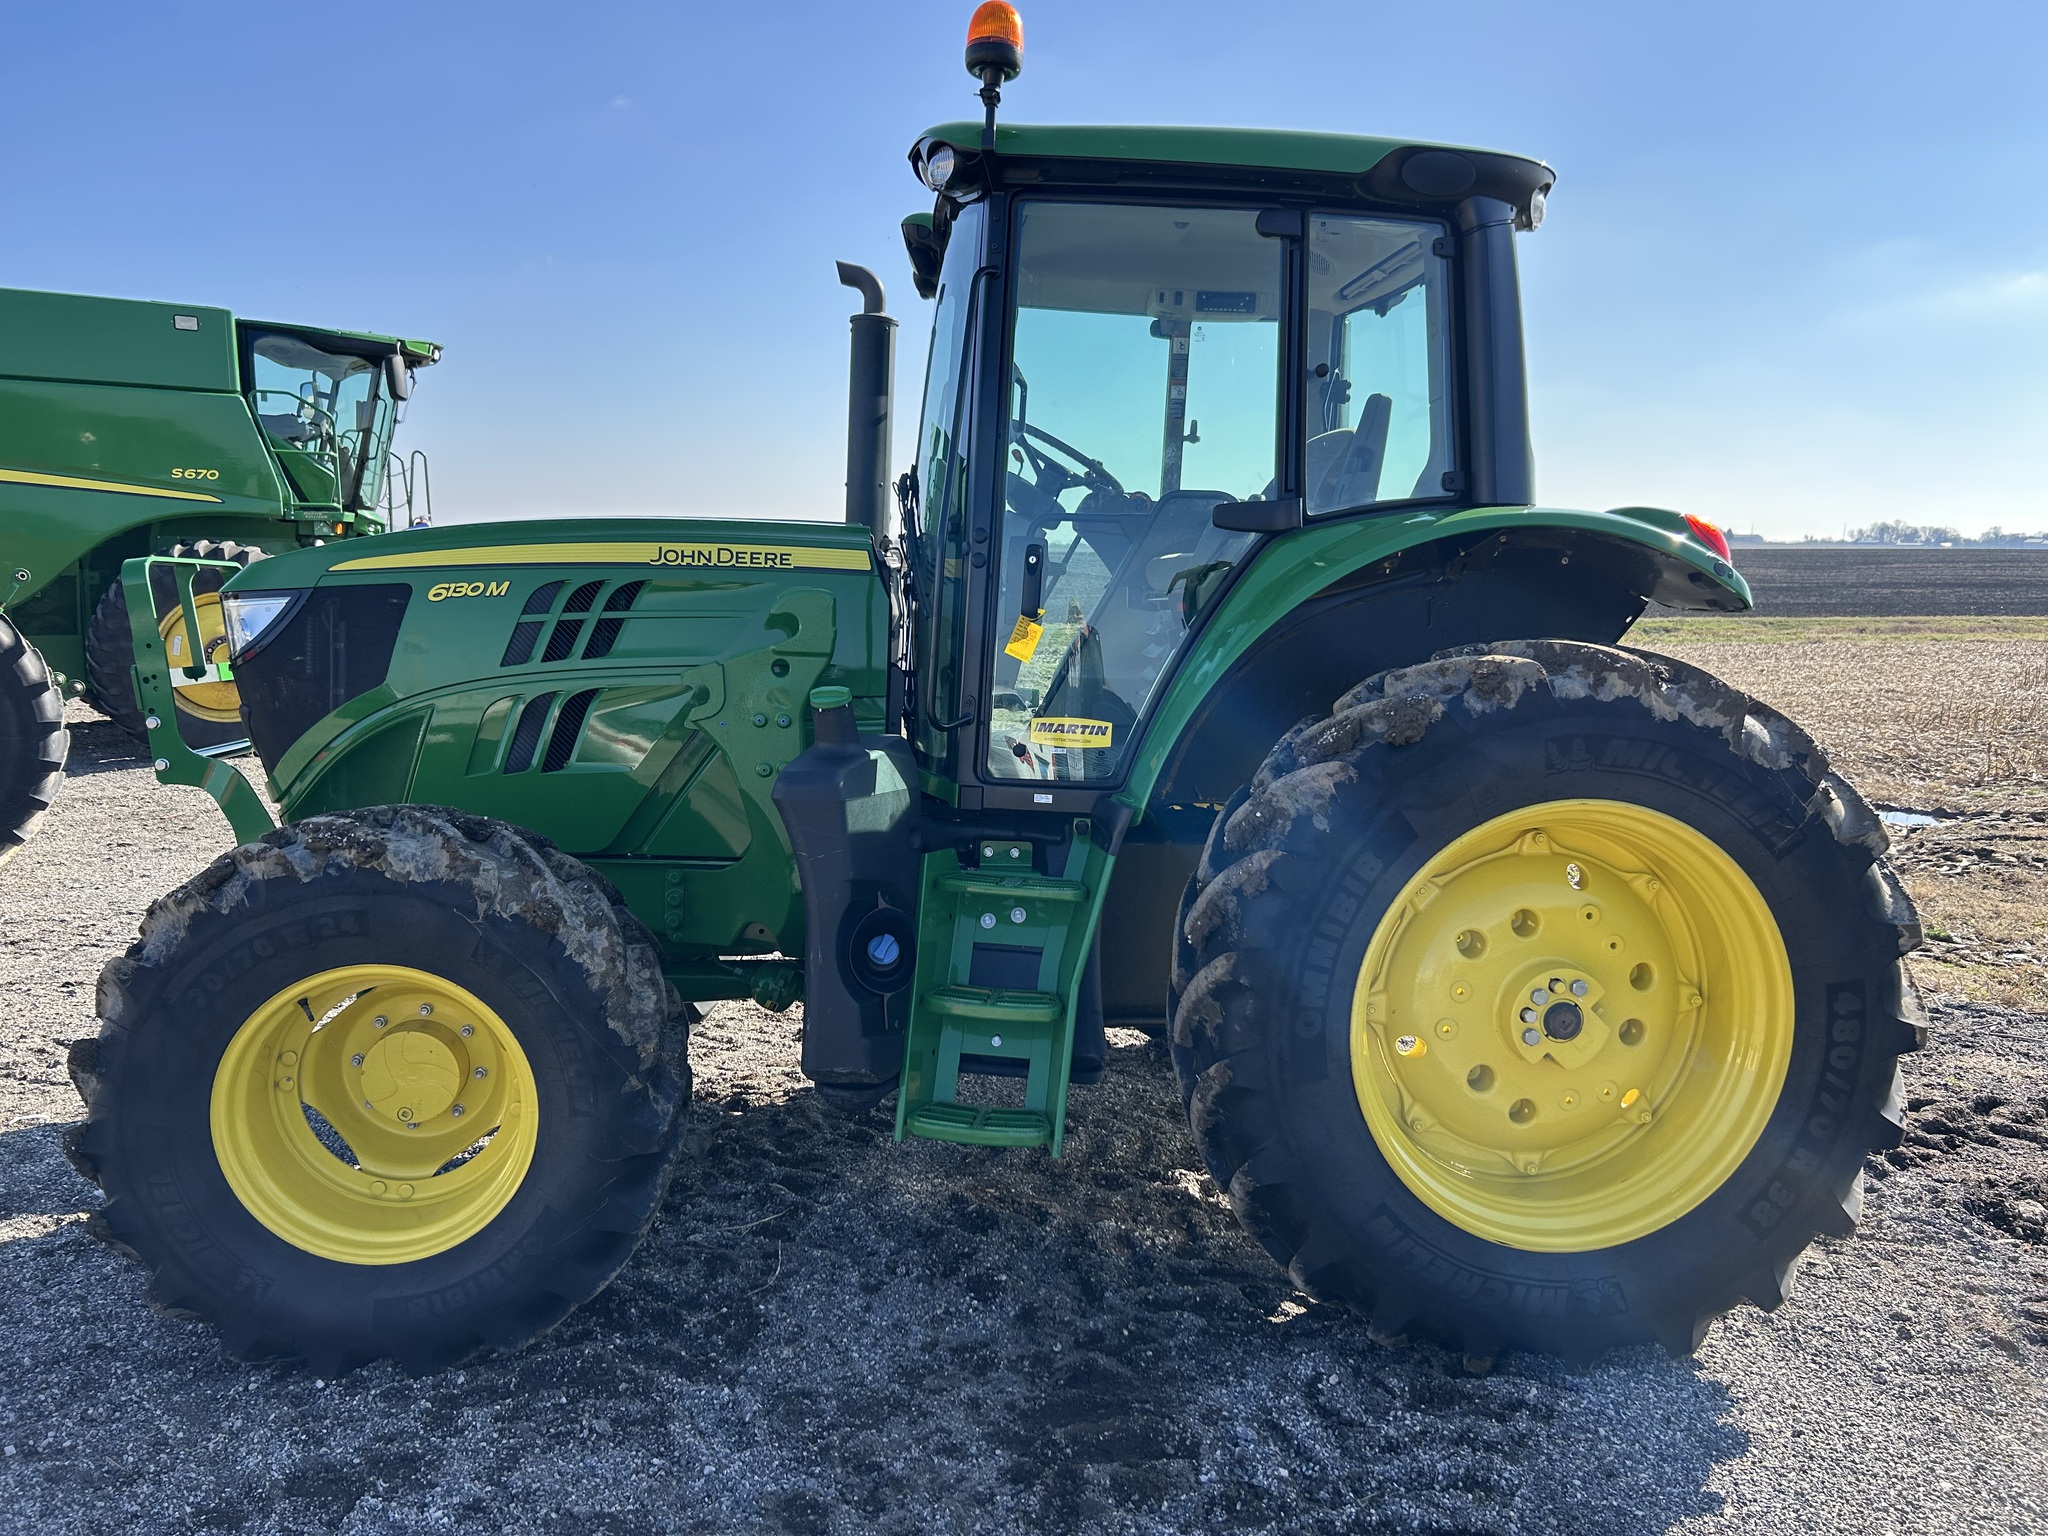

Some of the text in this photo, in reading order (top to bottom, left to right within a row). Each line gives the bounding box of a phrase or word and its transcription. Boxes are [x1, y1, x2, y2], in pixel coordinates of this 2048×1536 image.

[171, 468, 219, 480] S670
[650, 546, 793, 567] JOHN DEERE
[1035, 722, 1109, 736] MARTIN
[1600, 738, 1798, 850] MICHELIN
[1296, 851, 1384, 1038] OMNIBIB
[1750, 991, 1861, 1229] 480/70 R 38
